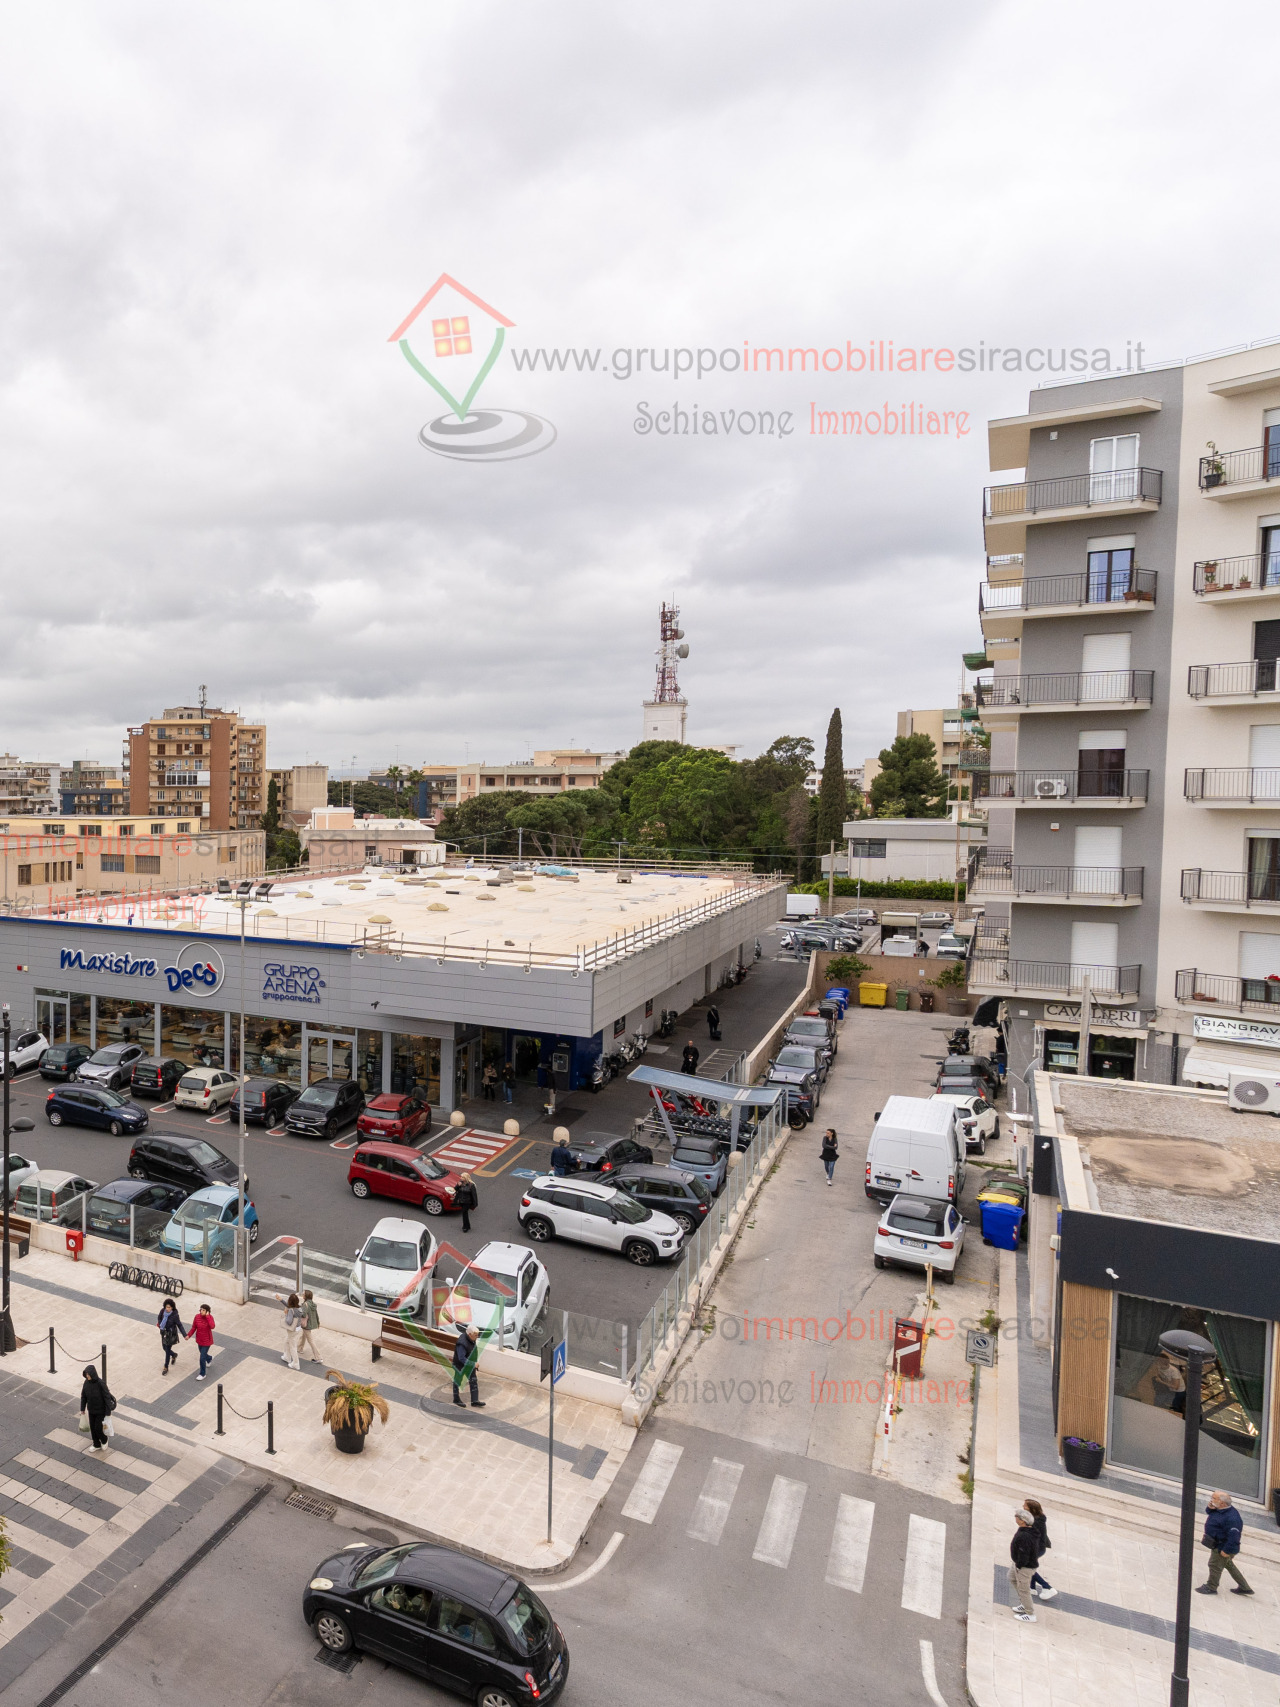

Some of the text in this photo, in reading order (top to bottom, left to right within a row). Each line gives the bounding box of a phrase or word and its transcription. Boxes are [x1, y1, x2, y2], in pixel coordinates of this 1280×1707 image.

[60, 948, 158, 978] Maxistore
[263, 963, 320, 980] GRUPPO
[263, 977, 320, 996] ARENA
[262, 992, 321, 1003] gruppoarena.it
[1047, 1004, 1137, 1023] CAVLIERI
